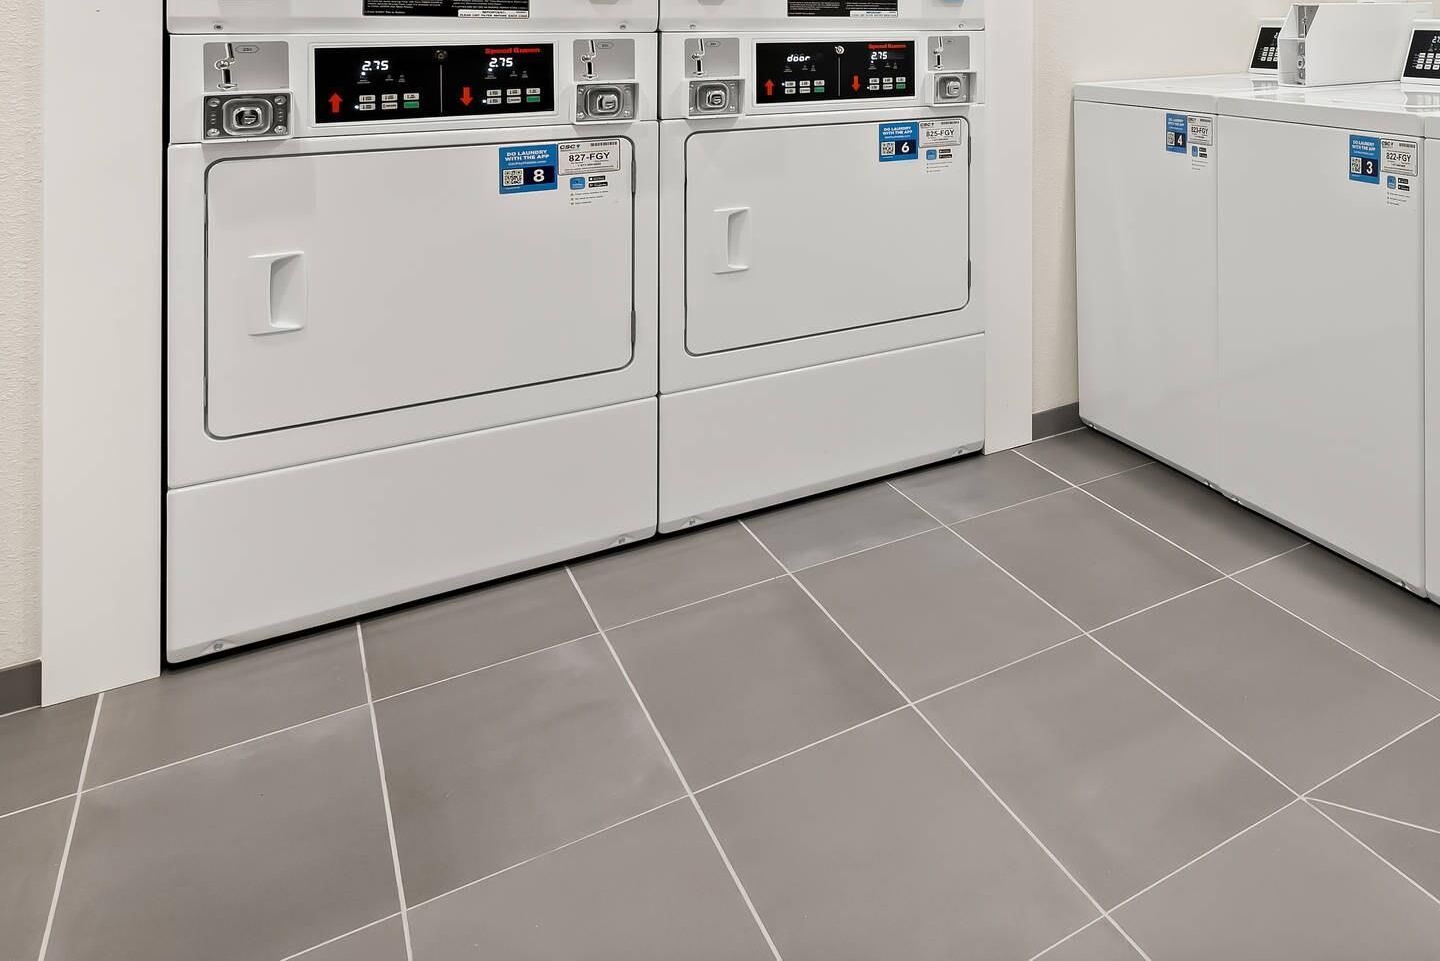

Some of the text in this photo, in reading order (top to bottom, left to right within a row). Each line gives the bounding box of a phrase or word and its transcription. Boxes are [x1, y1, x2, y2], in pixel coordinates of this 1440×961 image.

[484, 47, 512, 55] Speed
[362, 60, 388, 71] 2.75
[488, 57, 513, 67] 2.75
[926, 129, 955, 137] 825-FGY
[1178, 135, 1183, 145] 4
[902, 141, 910, 153] 6
[568, 152, 610, 162] 827-FGY
[1386, 152, 1411, 162] 822-FGY
[1366, 161, 1373, 174] 3
[533, 169, 545, 182] 8
